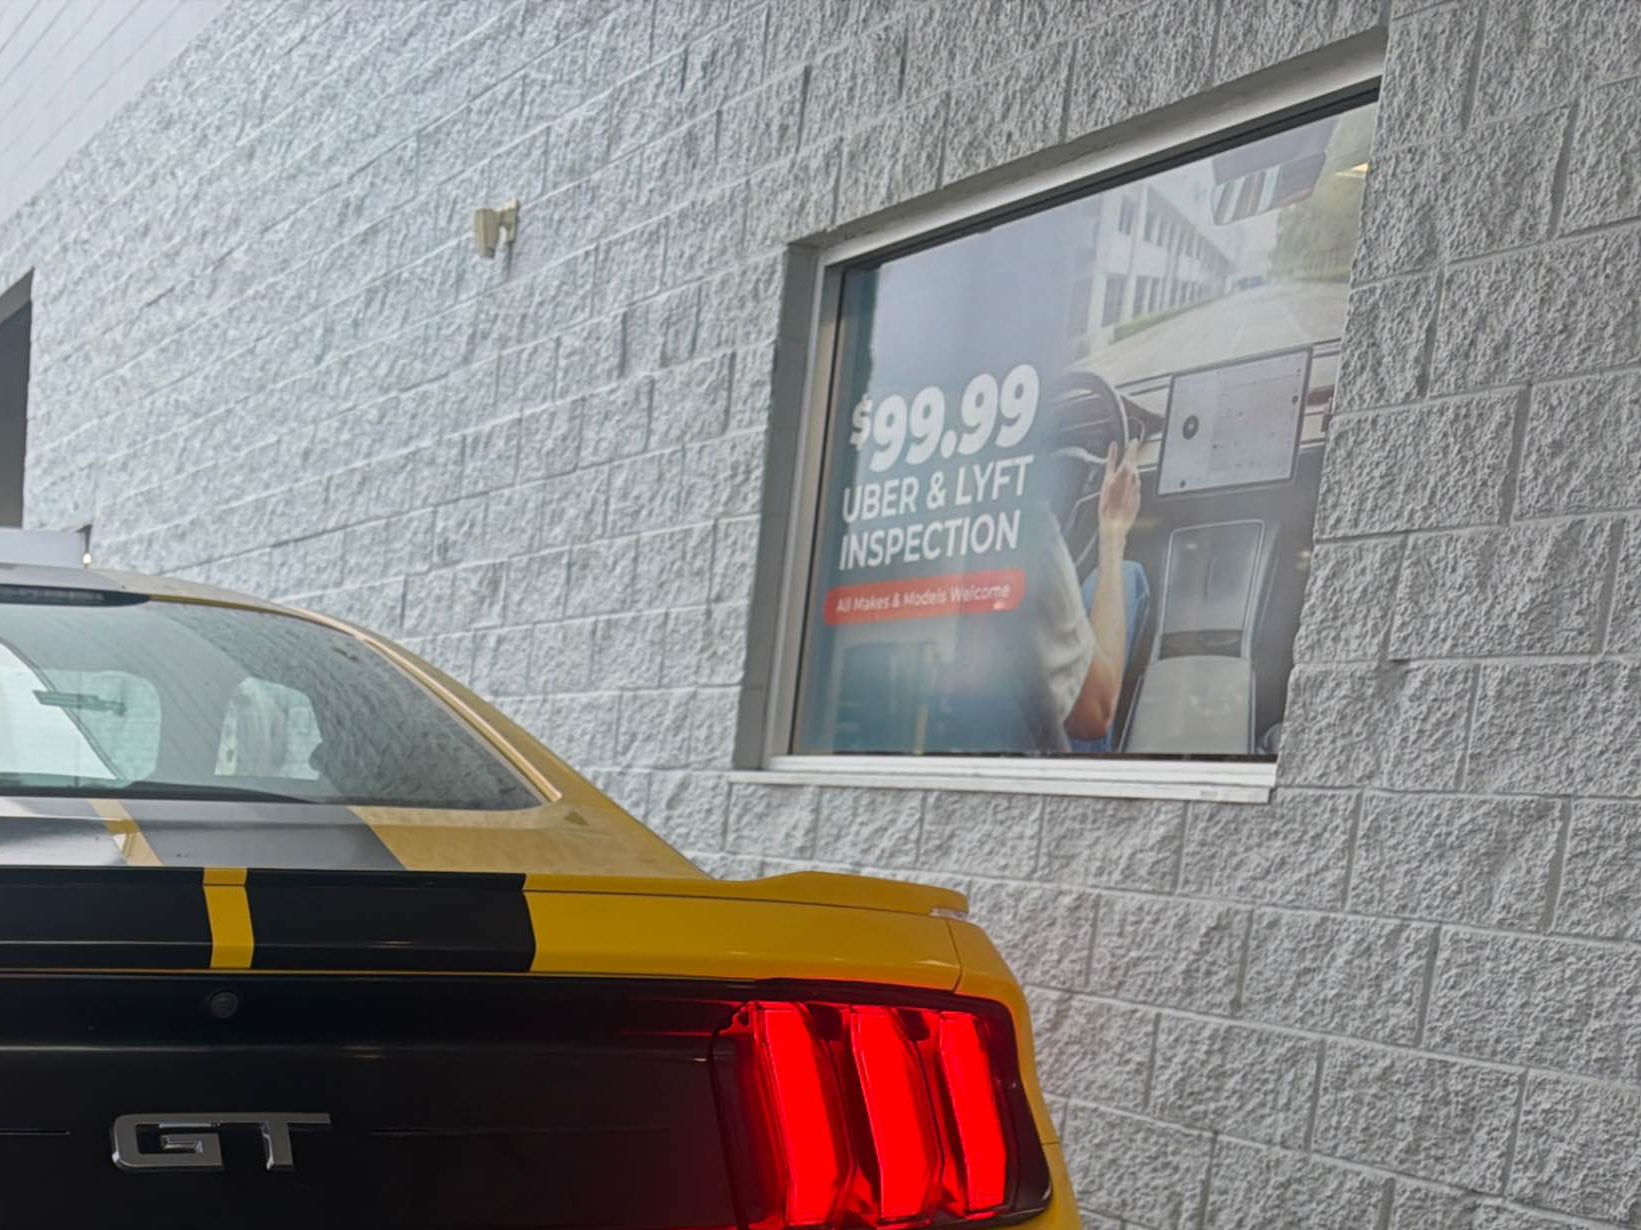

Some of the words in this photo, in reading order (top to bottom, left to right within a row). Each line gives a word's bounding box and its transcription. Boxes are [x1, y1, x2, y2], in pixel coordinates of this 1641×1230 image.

[849, 364, 1040, 473] $99.99
[842, 476, 919, 523] UBER
[925, 471, 946, 510] &
[955, 454, 1035, 506] LYFT
[838, 509, 1021, 571] INSPECTION
[836, 596, 851, 612] All
[853, 595, 890, 612] Makes
[891, 592, 900, 609] &
[902, 587, 946, 607] Models
[950, 584, 1011, 603] Welcome
[111, 1111, 332, 1170] GT
